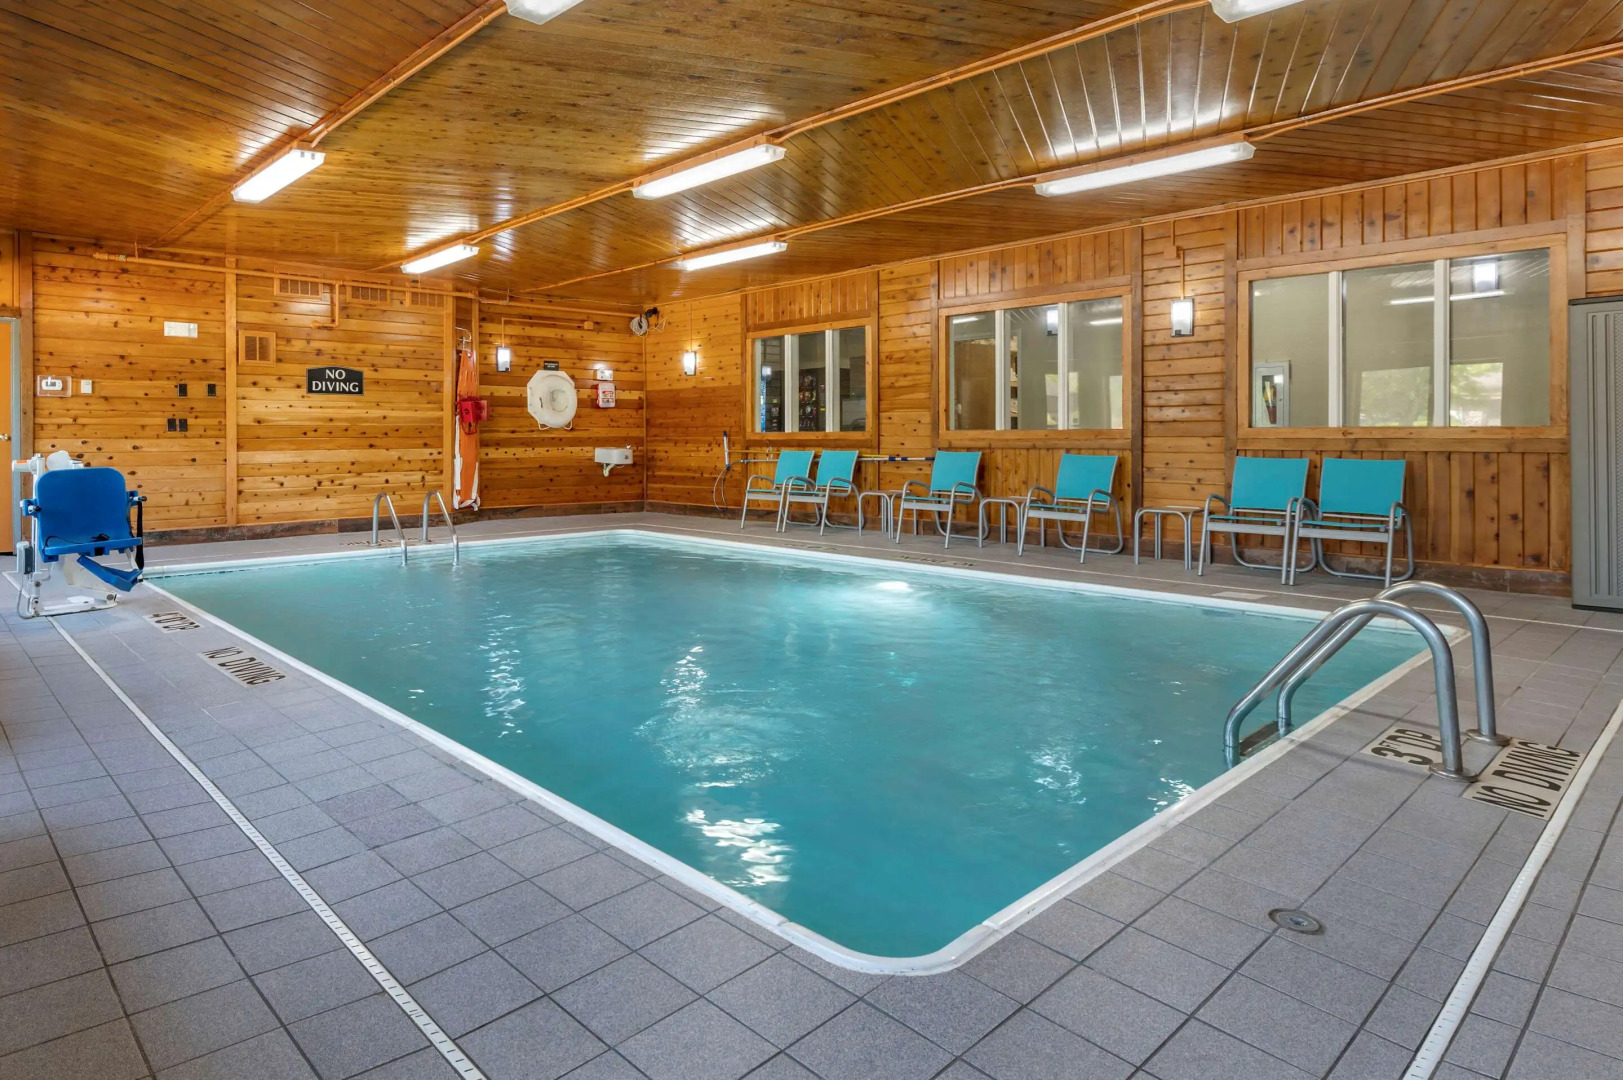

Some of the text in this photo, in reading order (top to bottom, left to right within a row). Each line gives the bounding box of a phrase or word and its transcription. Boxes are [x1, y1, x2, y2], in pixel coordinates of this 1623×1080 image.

[312, 380, 359, 392] DIVING
[325, 369, 346, 380] NO
[202, 646, 286, 685] NO DIVING
[1471, 741, 1581, 818] NO DIVING
